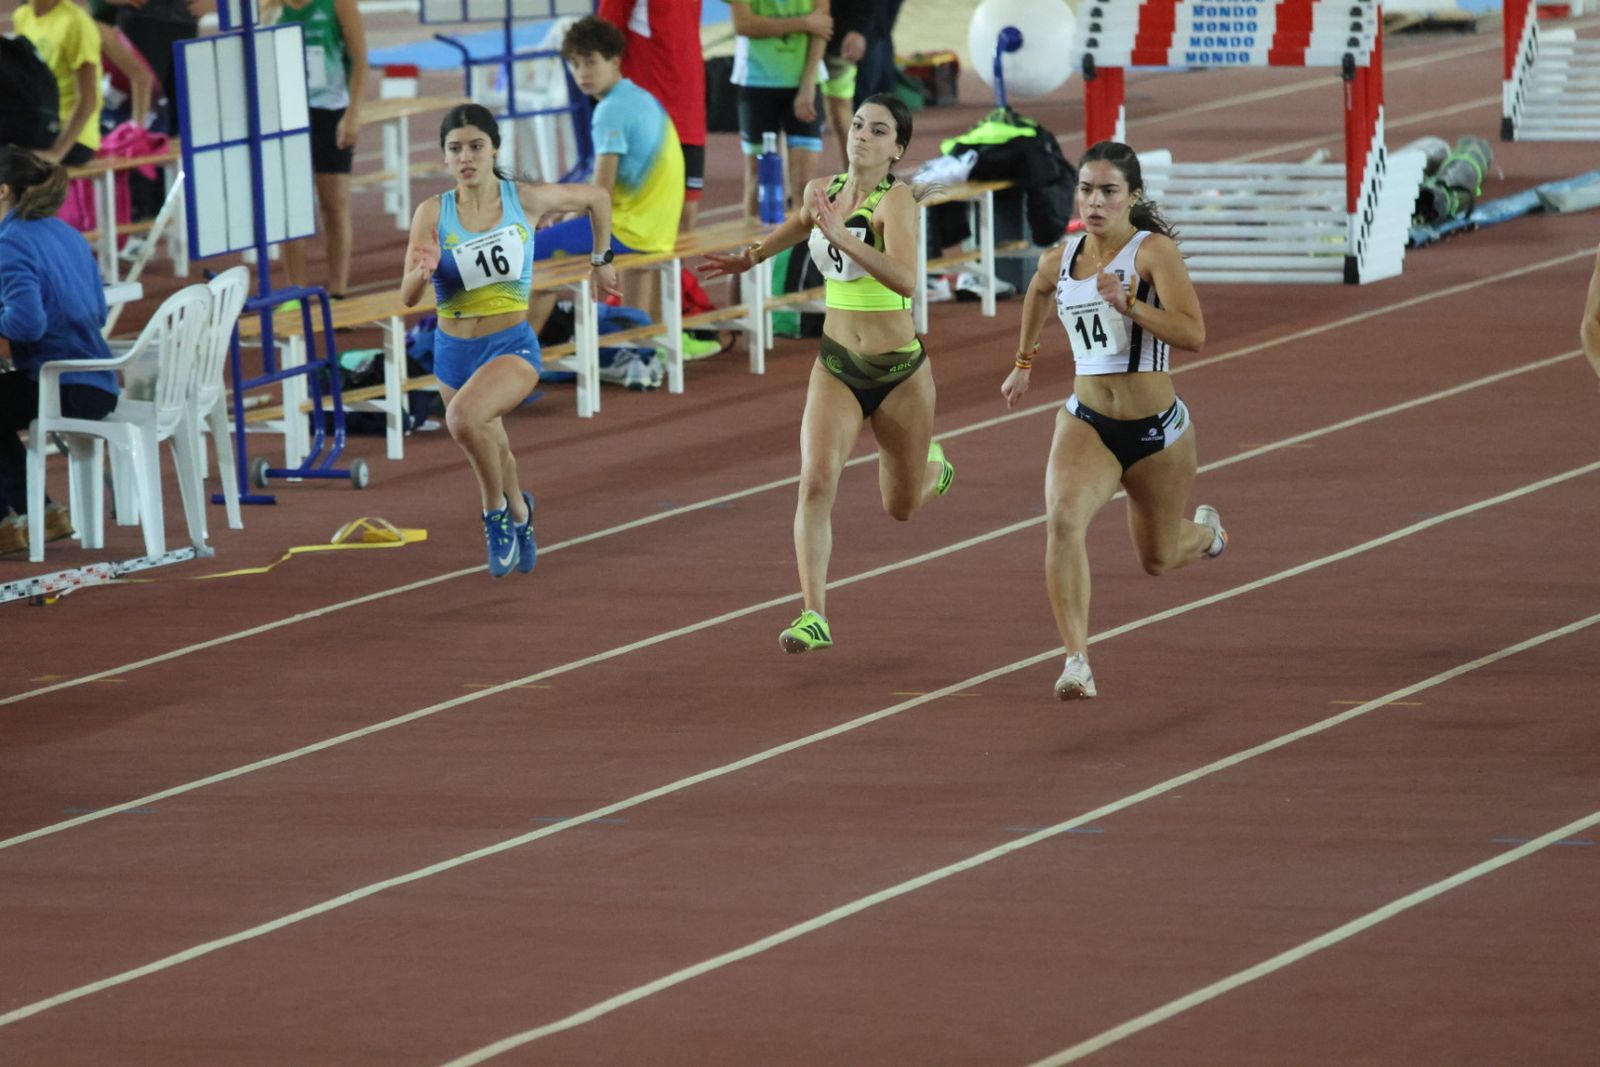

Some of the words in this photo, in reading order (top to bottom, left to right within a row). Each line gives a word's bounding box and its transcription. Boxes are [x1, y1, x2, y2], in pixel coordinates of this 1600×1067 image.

[1192, 5, 1257, 17] MONDO
[1192, 21, 1257, 32] MONDO
[1189, 36, 1254, 48] MONDO
[1185, 51, 1249, 63] MONDO
[475, 245, 510, 278] 16
[827, 243, 843, 274] 9
[1075, 313, 1108, 350] 14
